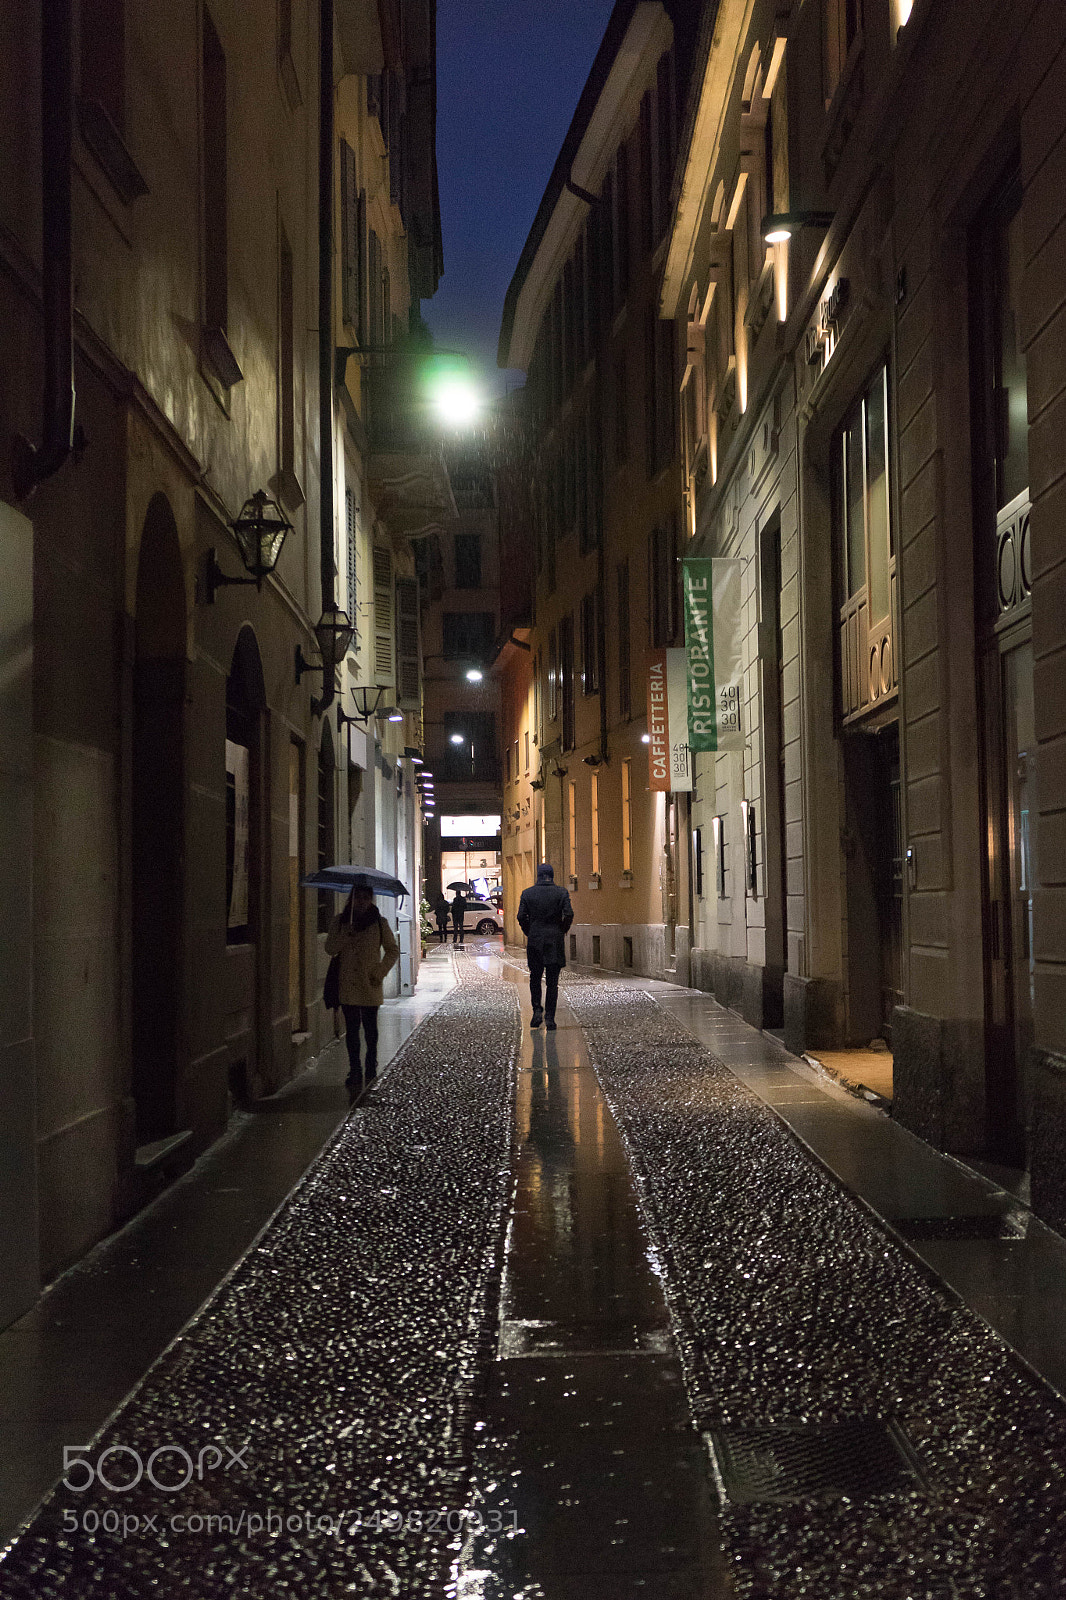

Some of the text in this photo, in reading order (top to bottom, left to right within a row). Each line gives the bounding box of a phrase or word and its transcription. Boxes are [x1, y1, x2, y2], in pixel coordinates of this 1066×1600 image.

[688, 577, 713, 734] RISTORANTE
[720, 686, 736, 698] 40
[720, 699, 736, 712] 30
[649, 663, 667, 779] CAFFETTERIA
[721, 713, 737, 726] 30
[673, 753, 685, 763] 30
[673, 763, 686, 773] 30
